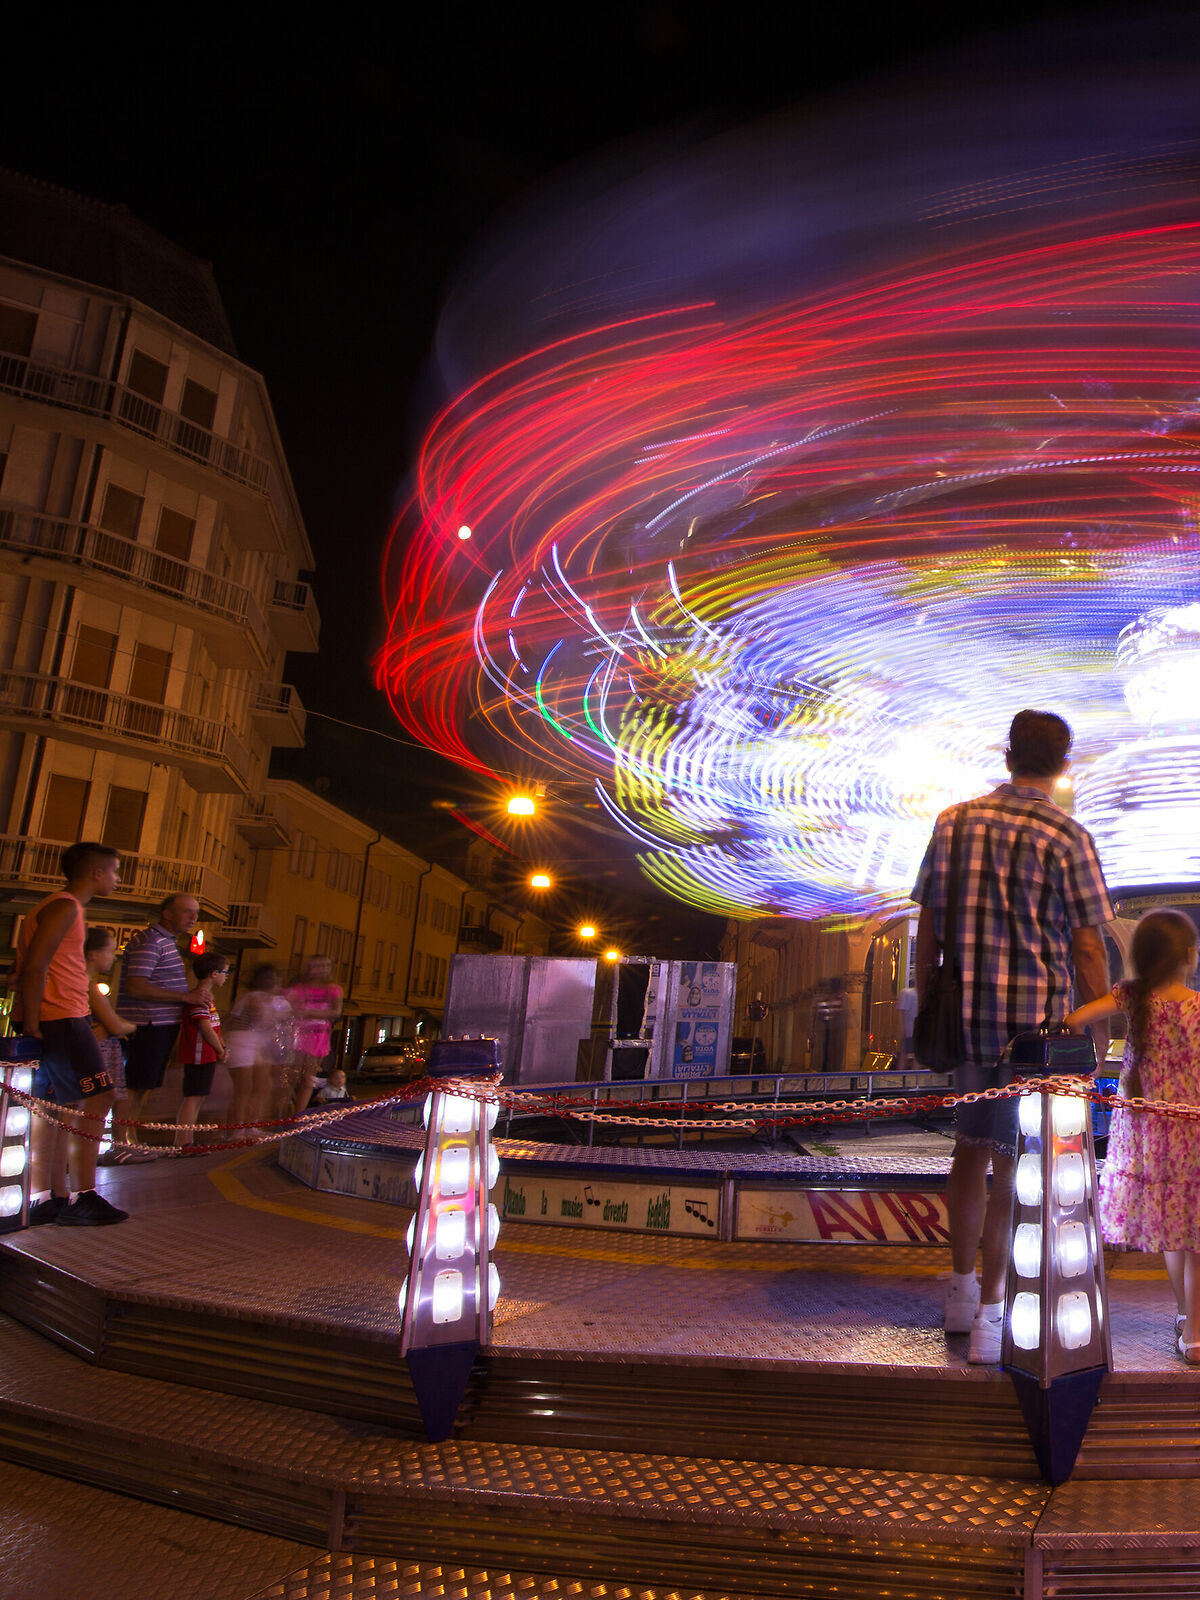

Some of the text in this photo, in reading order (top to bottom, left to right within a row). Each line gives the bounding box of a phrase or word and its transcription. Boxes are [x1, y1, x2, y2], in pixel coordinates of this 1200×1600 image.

[80, 1071, 113, 1093] ST
[540, 1189, 548, 1216] la
[561, 1196, 583, 1218] musica
[603, 1199, 629, 1224] diventa
[806, 1191, 950, 1243] AVIR
